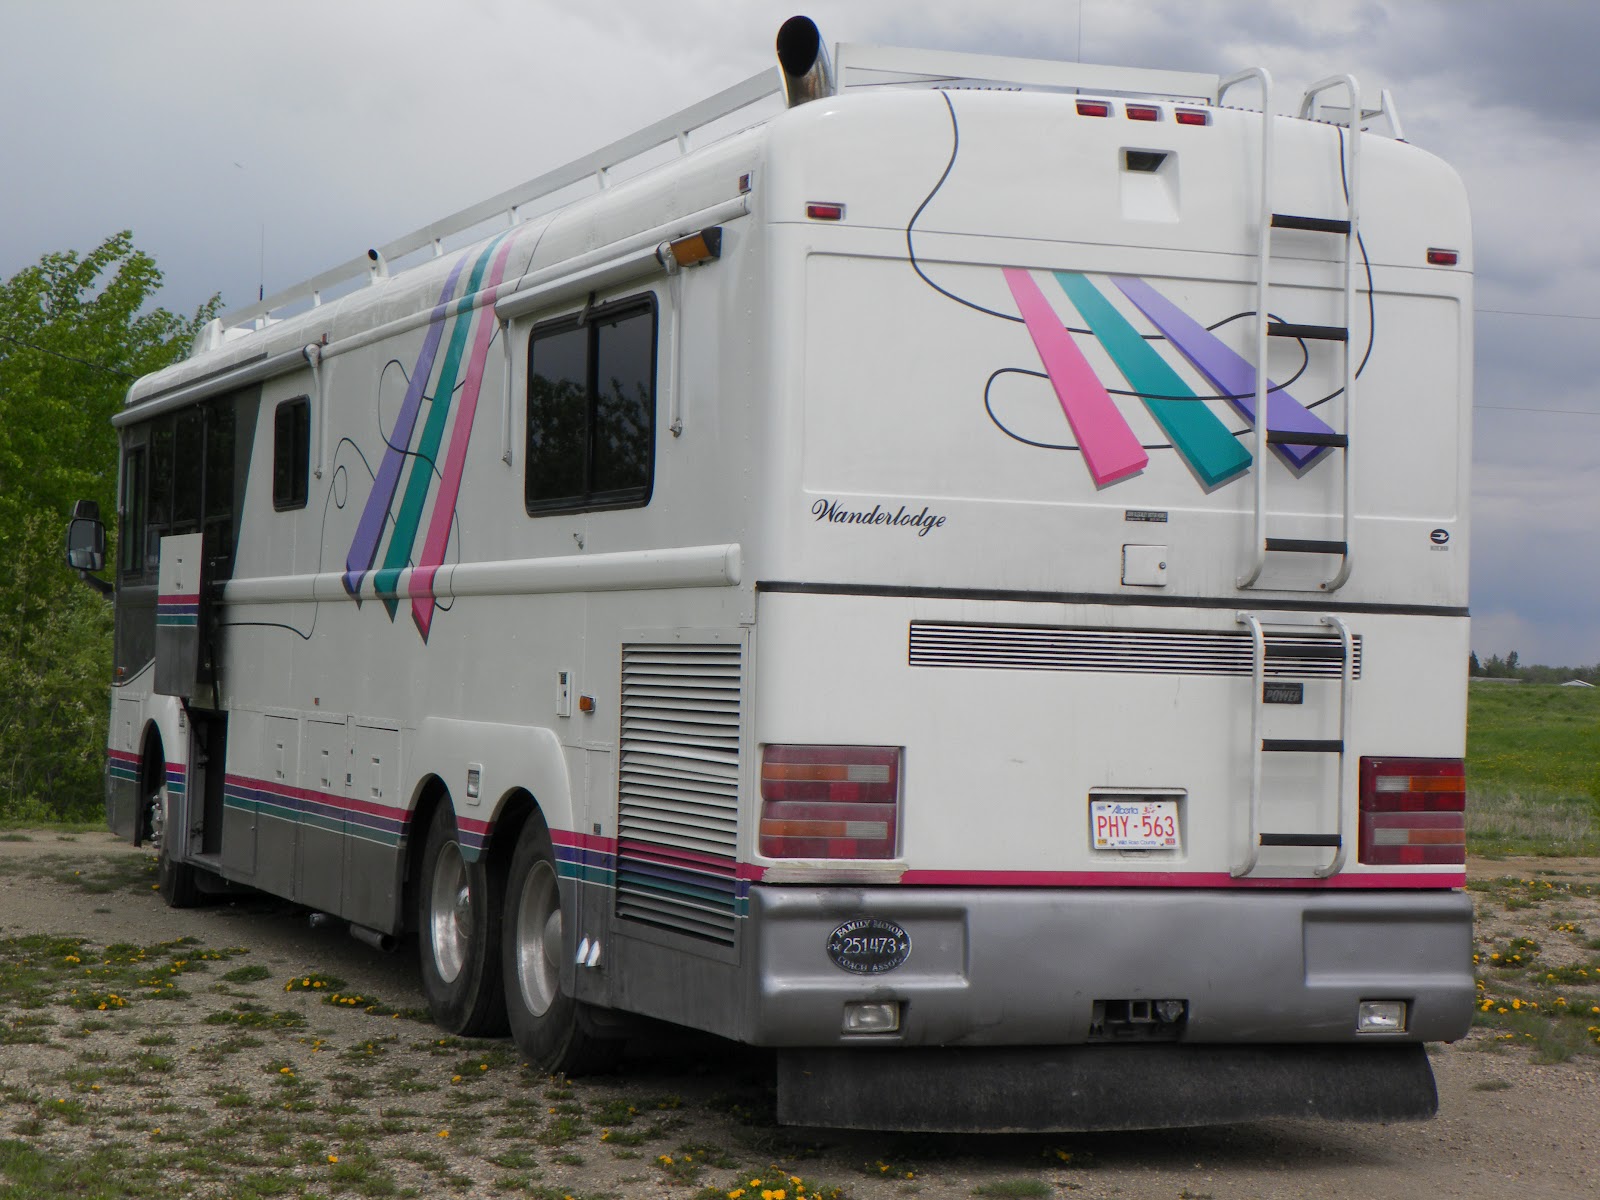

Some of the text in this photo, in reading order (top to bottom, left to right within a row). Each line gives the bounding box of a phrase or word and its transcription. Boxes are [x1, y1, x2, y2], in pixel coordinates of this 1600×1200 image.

[811, 498, 947, 537] Wanderlodge
[1265, 689, 1301, 702] POWER
[1111, 804, 1139, 815] Alberta
[836, 920, 904, 939] FAMILY MOTOR
[843, 938, 897, 954] 251473
[837, 956, 868, 971] COACH
